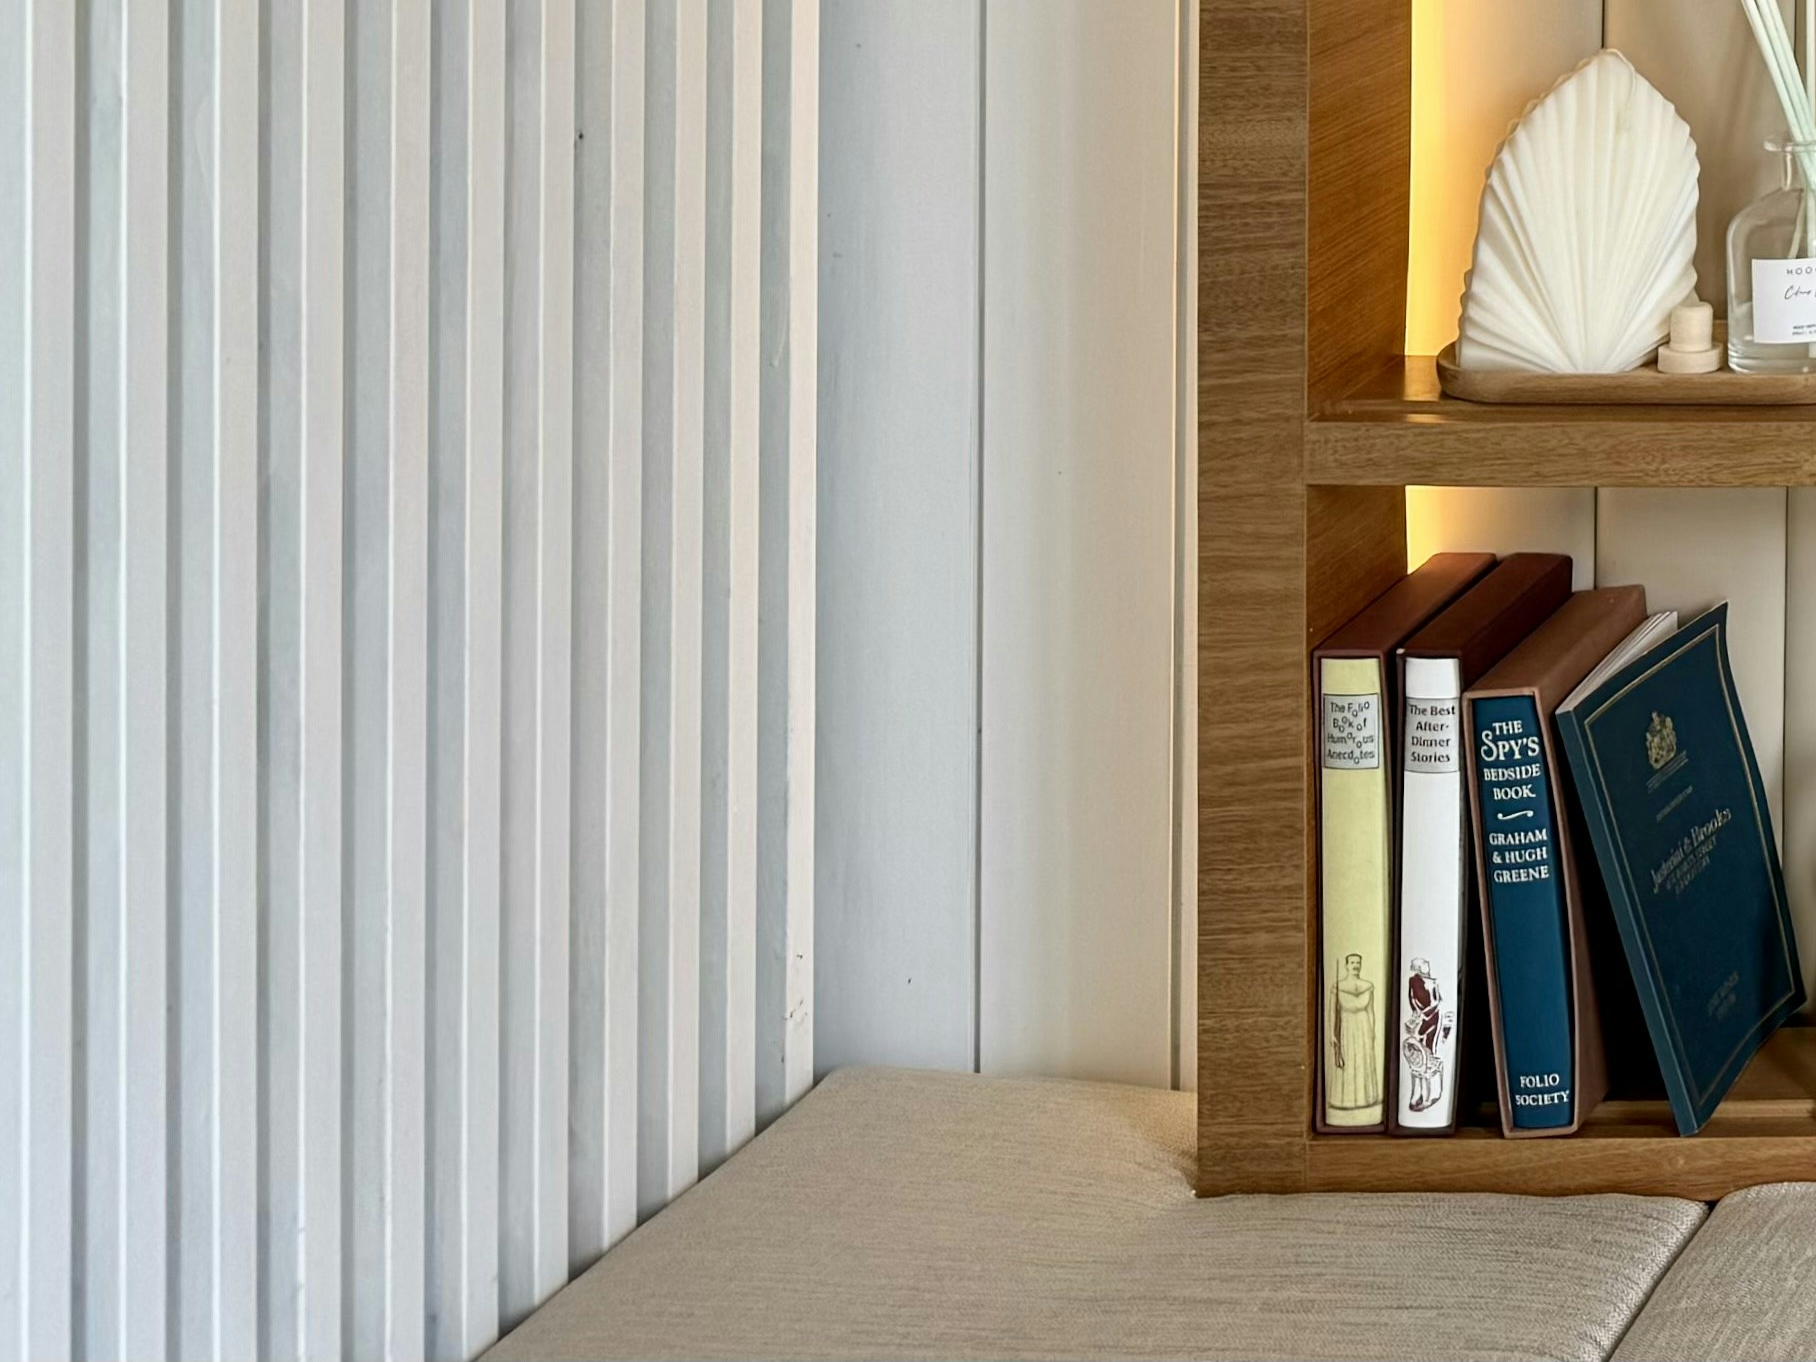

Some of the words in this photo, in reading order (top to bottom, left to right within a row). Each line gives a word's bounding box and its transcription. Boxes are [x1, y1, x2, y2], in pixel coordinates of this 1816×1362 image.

[1331, 702, 1345, 713] The
[1348, 701, 1370, 717] Folio
[1409, 704, 1427, 716] The
[1430, 705, 1455, 716] Best
[1333, 716, 1353, 733] Book
[1356, 717, 1367, 731] of
[1416, 721, 1449, 731] After-
[1492, 720, 1523, 735] THE
[1327, 732, 1374, 748] Humorous
[1411, 736, 1451, 747] Dinner
[1481, 730, 1540, 761] SPY'S
[1327, 749, 1375, 764] Anecdotes
[1411, 751, 1450, 762] Stories
[1484, 764, 1541, 781] BEDSIDE
[1493, 784, 1536, 800] BOOK
[1691, 808, 1732, 848] Brooks
[1489, 829, 1547, 845] GRAHAM
[1493, 851, 1502, 863] &
[1506, 847, 1547, 863] HUGH
[1494, 866, 1549, 883] GREENE
[1520, 1073, 1559, 1088] FOLIO
[1515, 1090, 1569, 1105] SOCIETY
